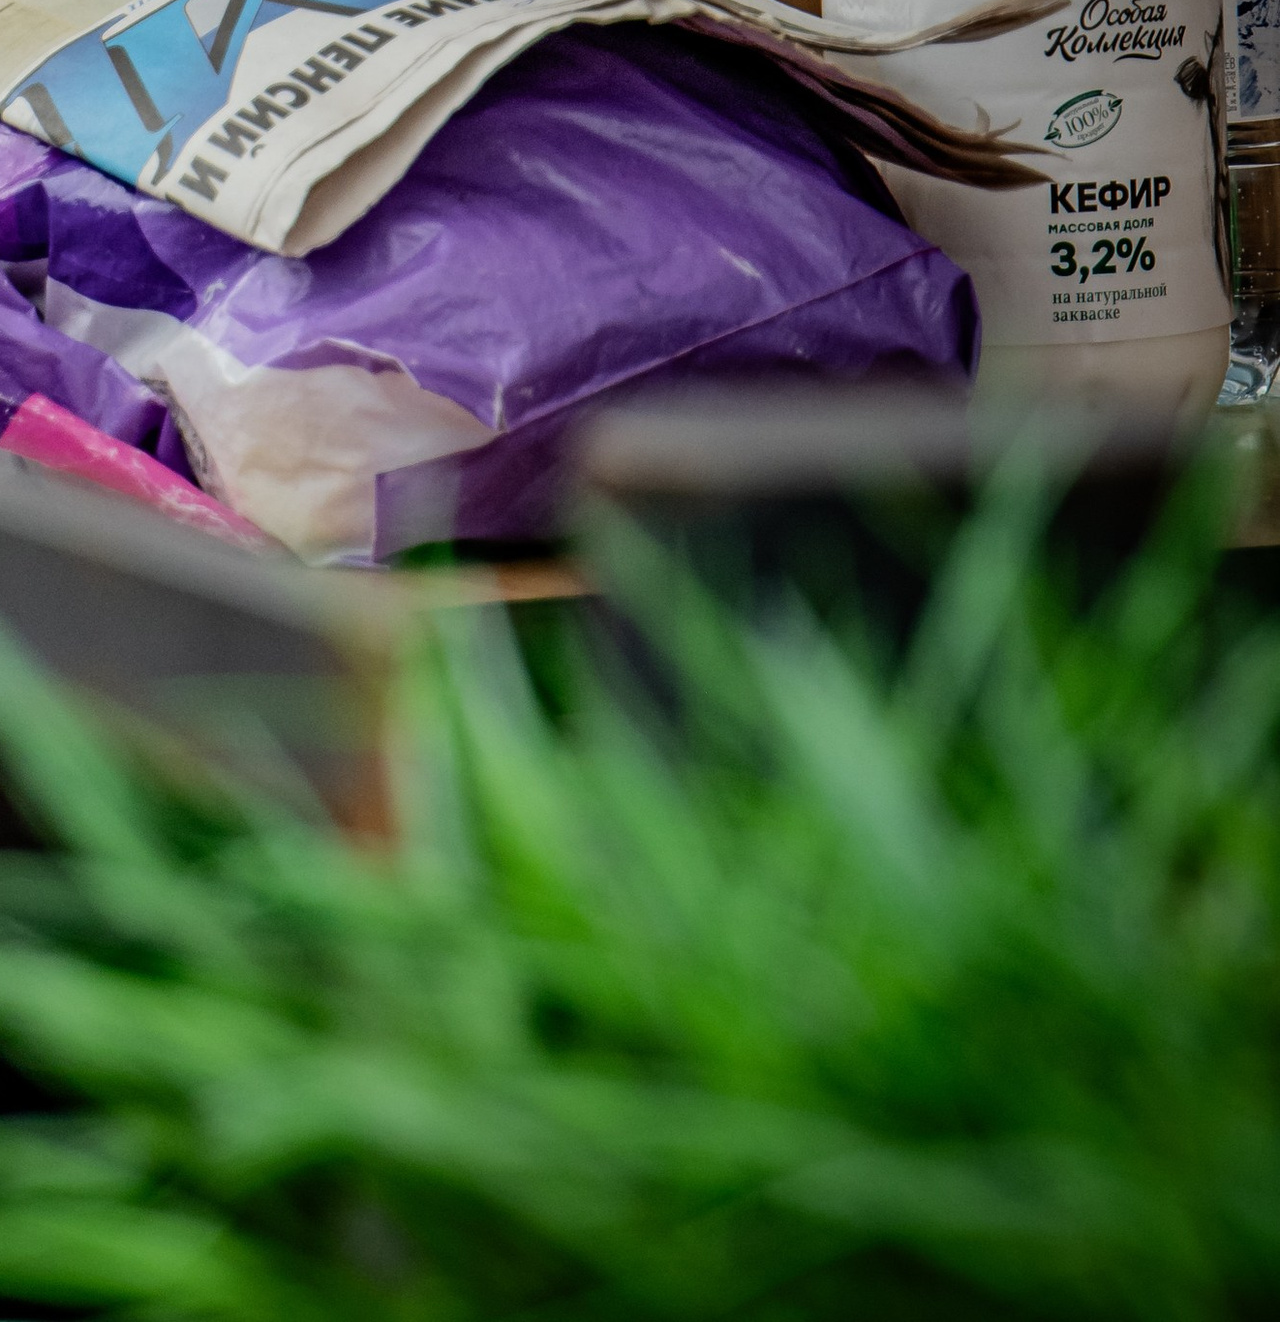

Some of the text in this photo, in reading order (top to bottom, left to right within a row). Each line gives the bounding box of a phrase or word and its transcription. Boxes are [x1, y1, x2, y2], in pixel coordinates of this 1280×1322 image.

[1044, 24, 1187, 62] Коллекция
[203, 28, 397, 160] ПЕНСИЙ
[1064, 103, 1110, 137] 100%
[174, 156, 230, 204] И
[1050, 176, 1171, 214] КЕФИР
[1048, 217, 1155, 234] МАССОВАЯ ДОЛЯ
[1049, 237, 1156, 283] 3,2%
[1052, 283, 1168, 305] на натуральной
[1052, 307, 1121, 323] закваске
